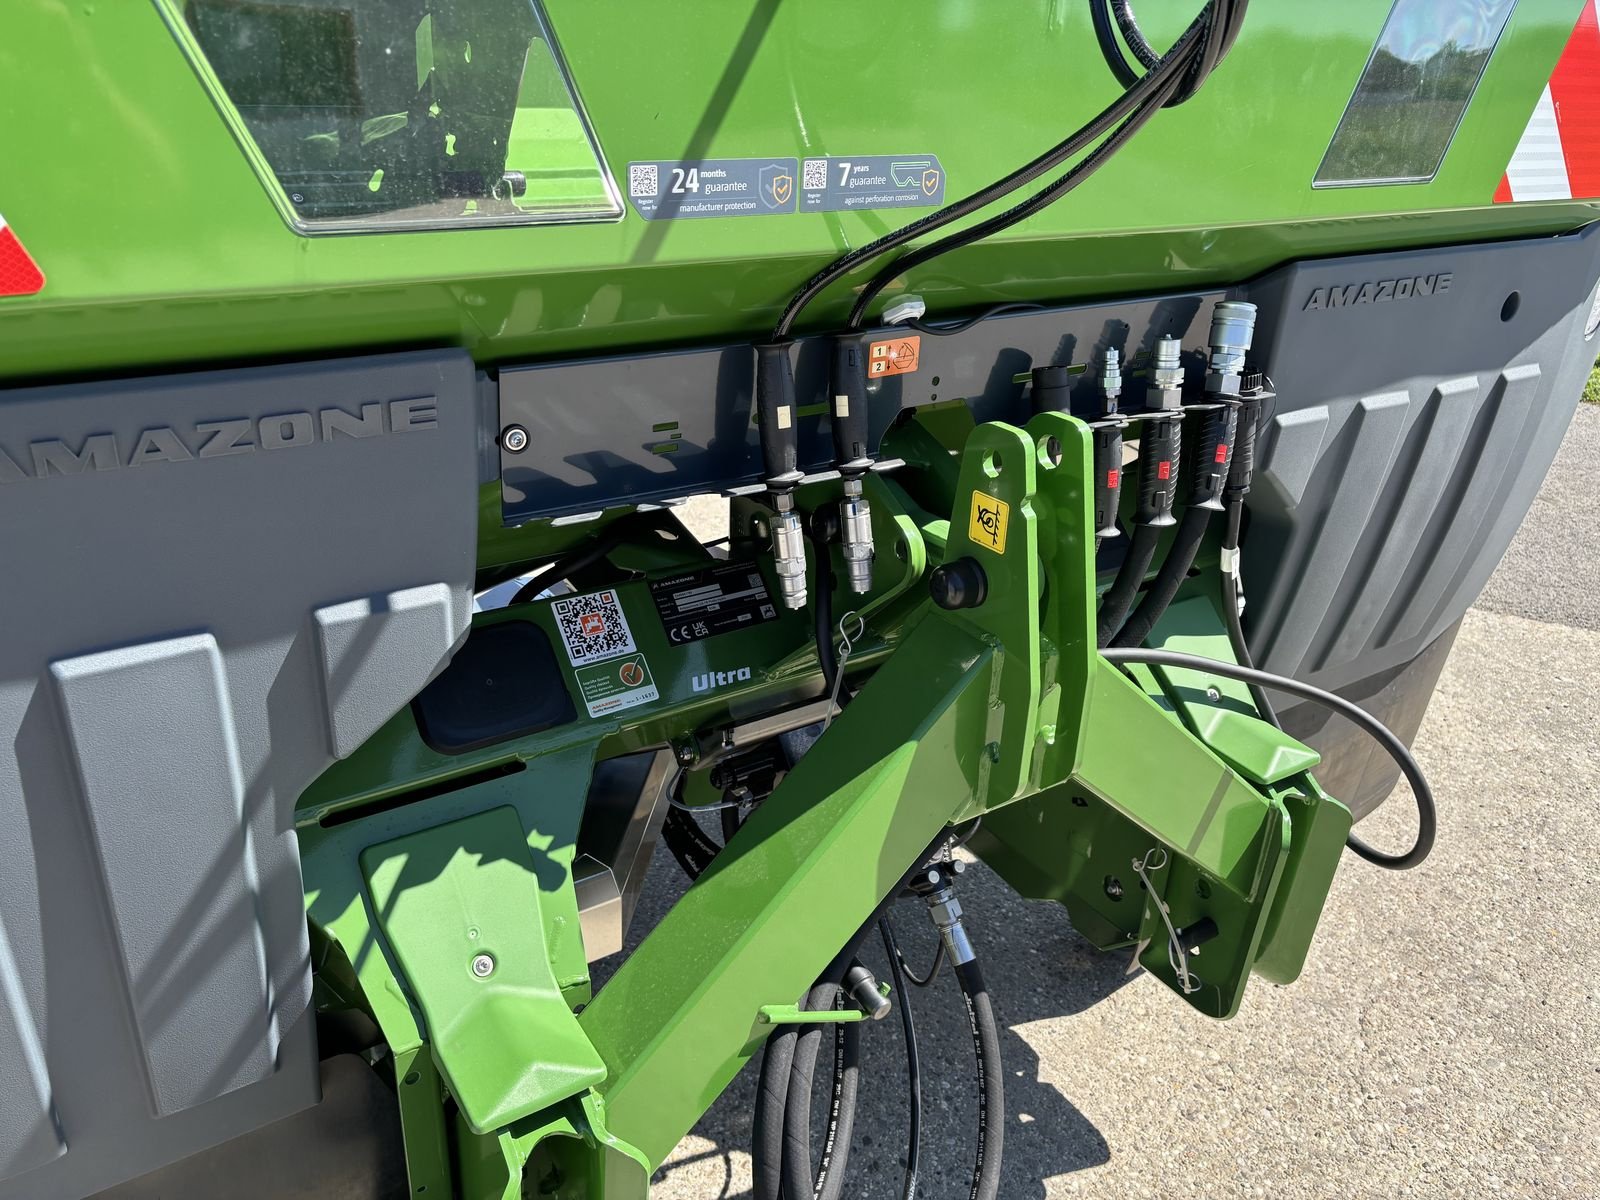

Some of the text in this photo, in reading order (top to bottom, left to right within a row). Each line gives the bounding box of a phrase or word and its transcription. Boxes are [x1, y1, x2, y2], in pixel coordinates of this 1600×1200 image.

[671, 167, 726, 194] 24 months
[838, 163, 870, 186] 7 years
[705, 182, 748, 195] guarantee
[849, 176, 887, 188] guarantee
[844, 193, 919, 206] against perforation corrosion
[679, 202, 756, 212] manufacturer protection
[1302, 272, 1454, 312] AMAZONE
[877, 347, 882, 356] 1
[876, 362, 882, 371] 2
[660, 576, 695, 588] AMAZONE
[692, 666, 751, 692] Ultra
